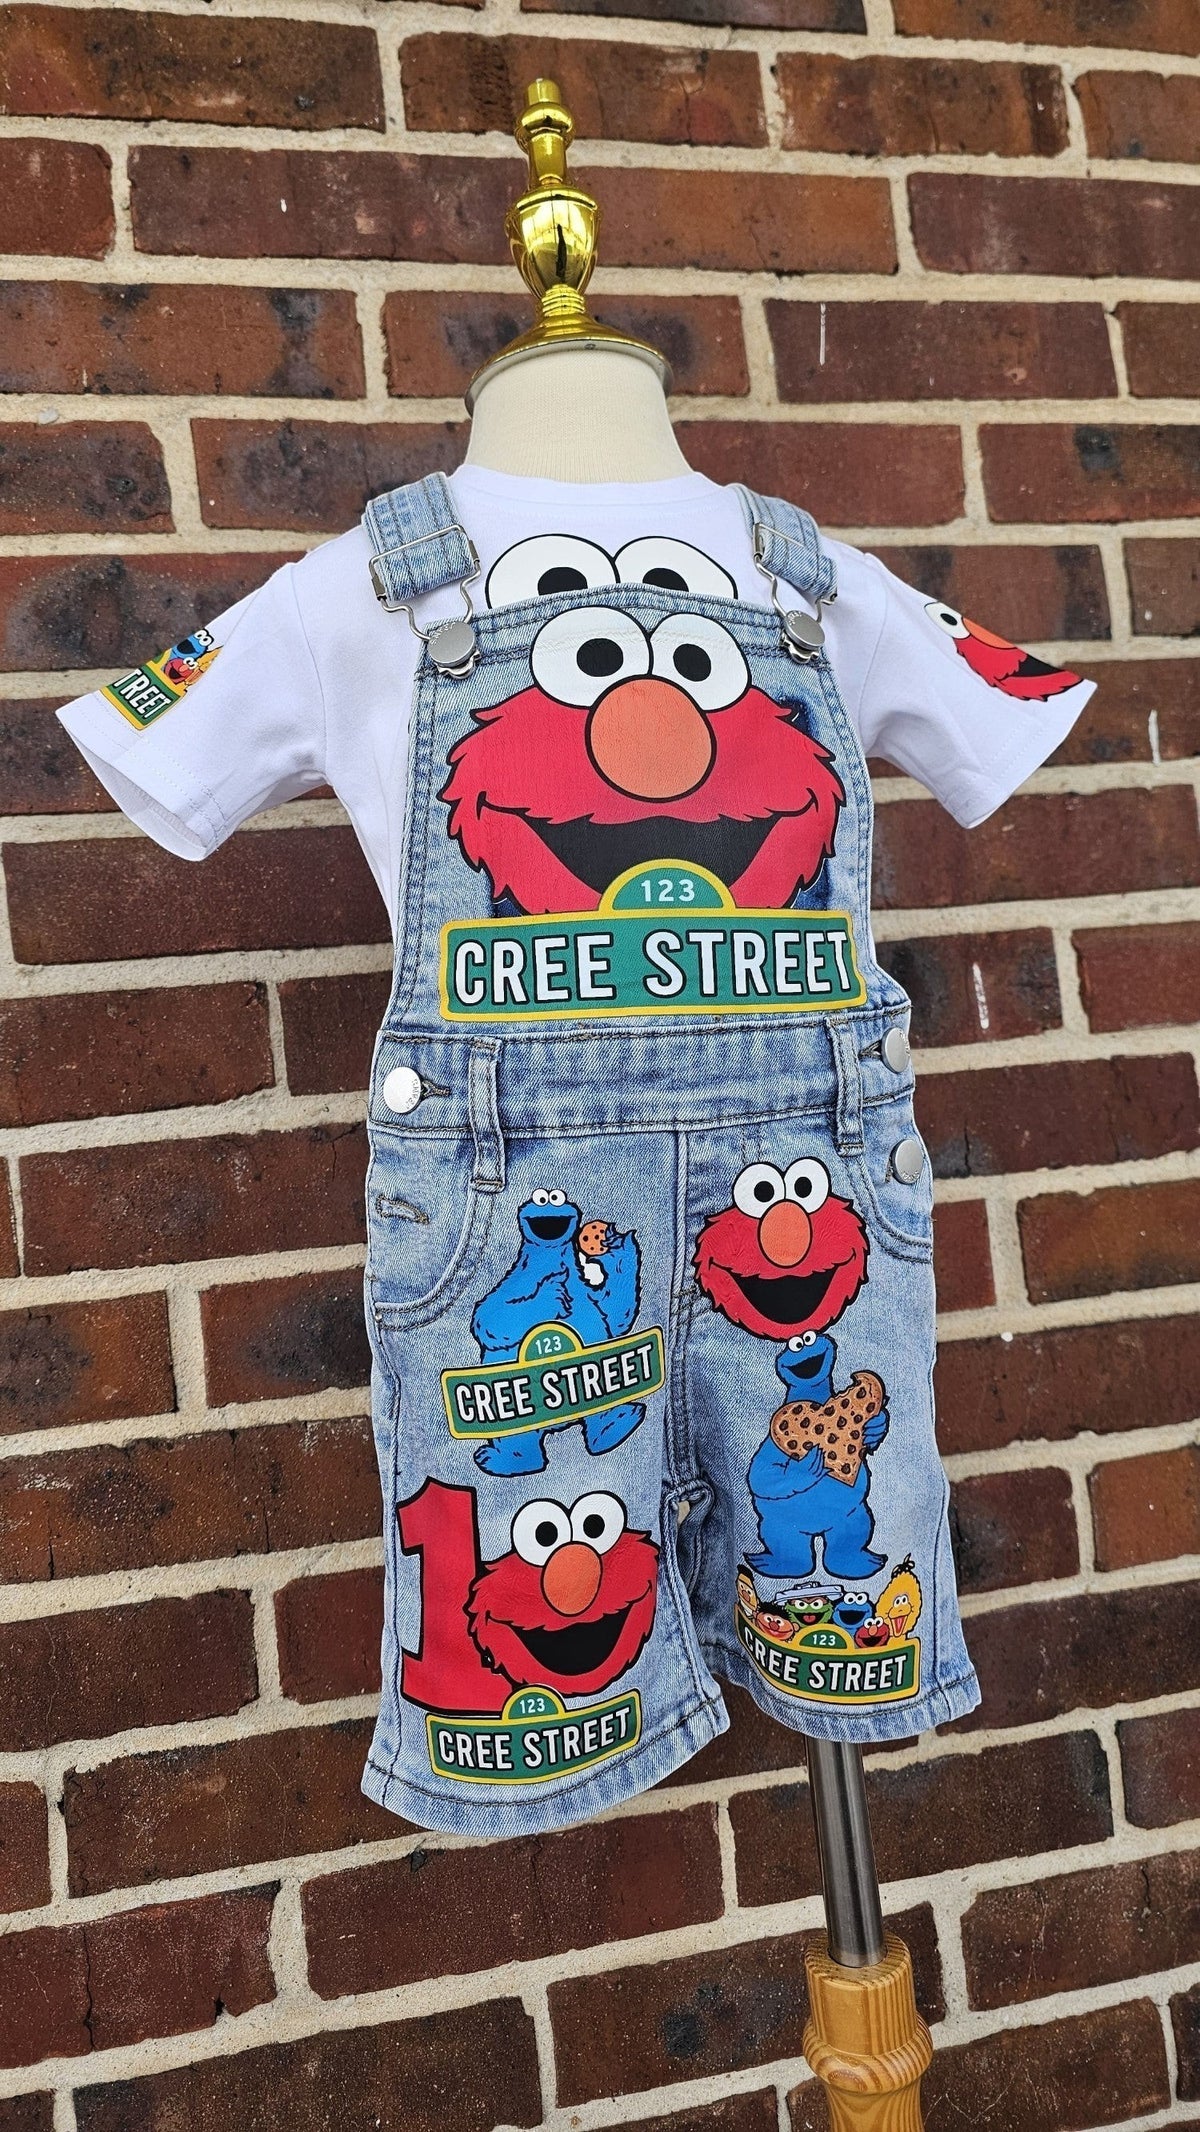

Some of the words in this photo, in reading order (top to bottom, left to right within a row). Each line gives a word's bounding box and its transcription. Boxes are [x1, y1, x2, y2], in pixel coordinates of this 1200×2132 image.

[640, 878, 695, 902] 123
[453, 930, 616, 1006] CREE
[644, 929, 852, 998] STREET
[535, 1335, 562, 1355] 123
[455, 1377, 534, 1422] CREE
[542, 1344, 653, 1409] STREET
[397, 1476, 513, 1714] 1
[744, 1627, 800, 1684] CREE
[808, 1654, 907, 1692] STREET
[812, 1633, 836, 1647] 123
[438, 1730, 513, 1770] CREE
[523, 1706, 631, 1768] STREET
[519, 1697, 546, 1715] 123
